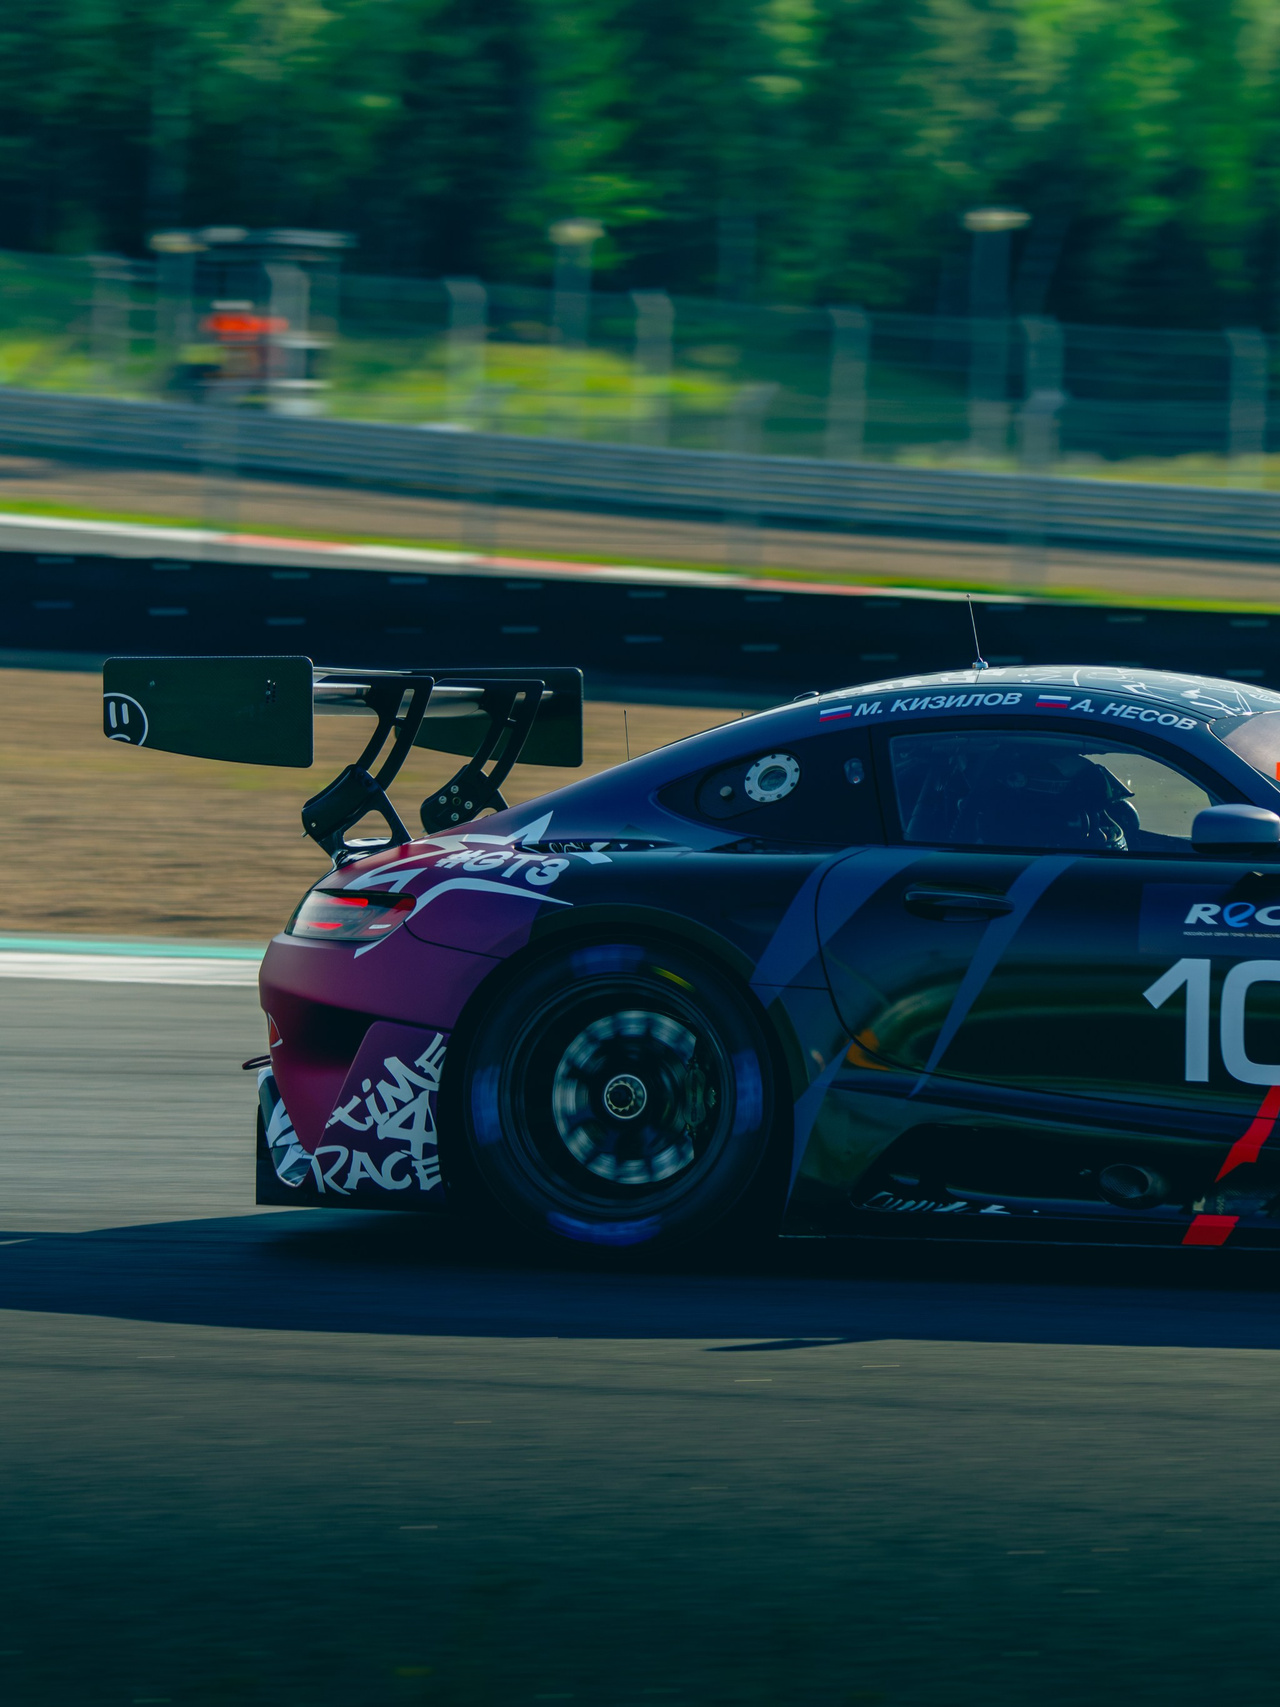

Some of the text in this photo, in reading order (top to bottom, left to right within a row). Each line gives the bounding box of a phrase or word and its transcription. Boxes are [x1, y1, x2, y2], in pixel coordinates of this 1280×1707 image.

[854, 692, 1023, 717] М. КИЗИЛОВ
[1069, 699, 1198, 730] А. НЕСОВ
[434, 850, 570, 886] #GT3
[377, 1090, 438, 1160] 4
[311, 1145, 442, 1195] RACE
